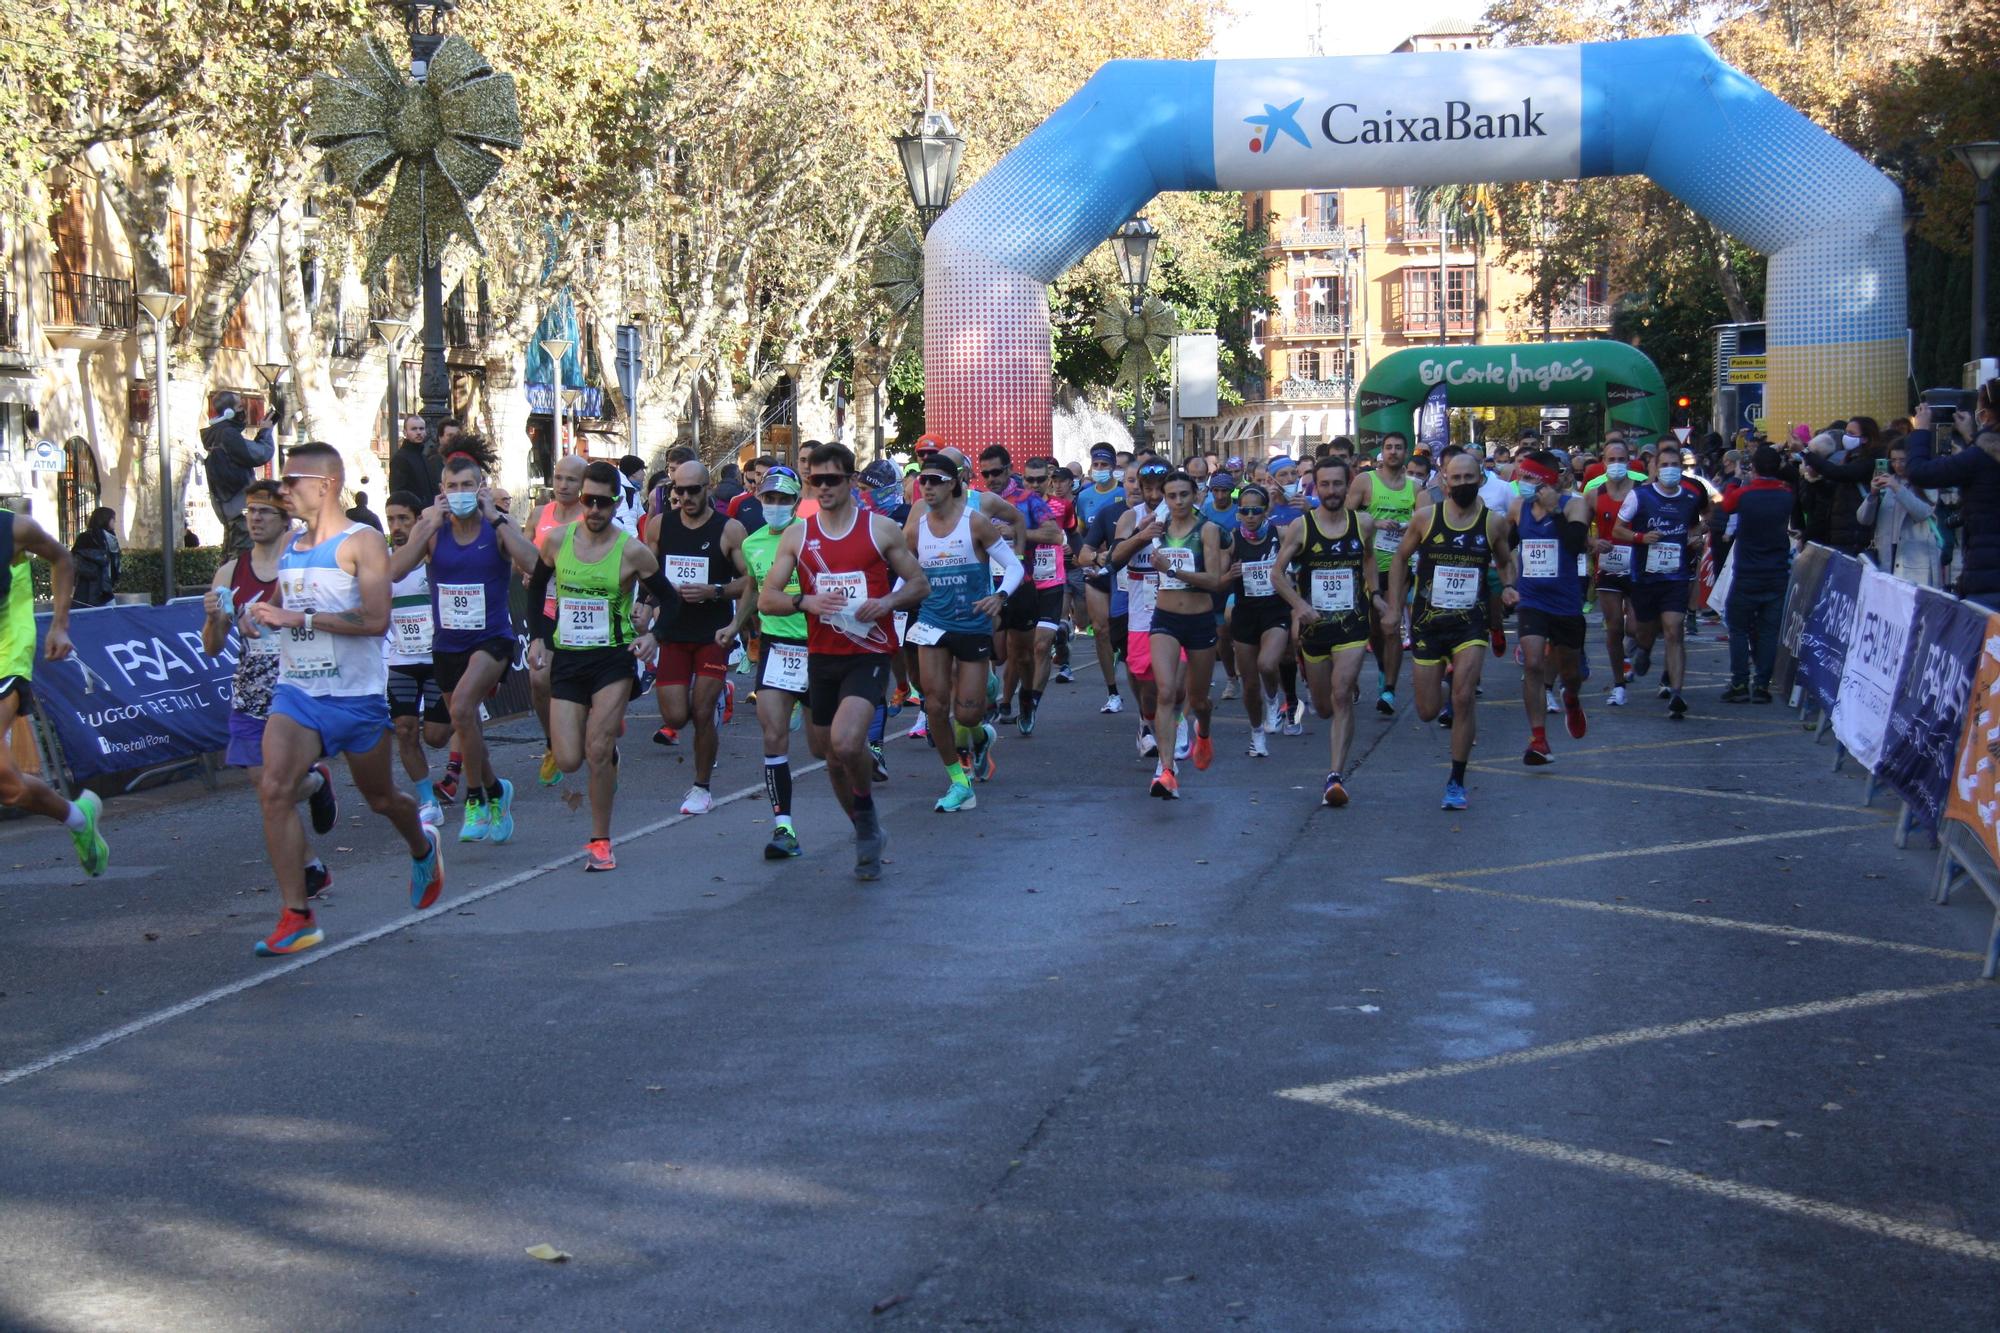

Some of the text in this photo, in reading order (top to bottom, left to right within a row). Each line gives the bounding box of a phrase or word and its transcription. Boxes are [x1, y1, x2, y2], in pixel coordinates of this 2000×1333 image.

[1321, 97, 1548, 145] CaixaBank
[1731, 358, 1753, 366] Palma
[1418, 352, 1594, 393] El Corte Inglés
[33, 460, 57, 469] ATM
[866, 475, 885, 488] tribe
[1529, 549, 1546, 559] 491
[945, 557, 968, 566] SPORT
[677, 567, 696, 578] 265
[1322, 580, 1342, 591] 933
[1446, 578, 1466, 589] 707
[453, 596, 468, 608] 89
[572, 611, 594, 624] 231
[401, 624, 420, 635] 369
[104, 637, 194, 686] PSA
[782, 657, 801, 670] 132
[148, 692, 210, 714] RETAIL
